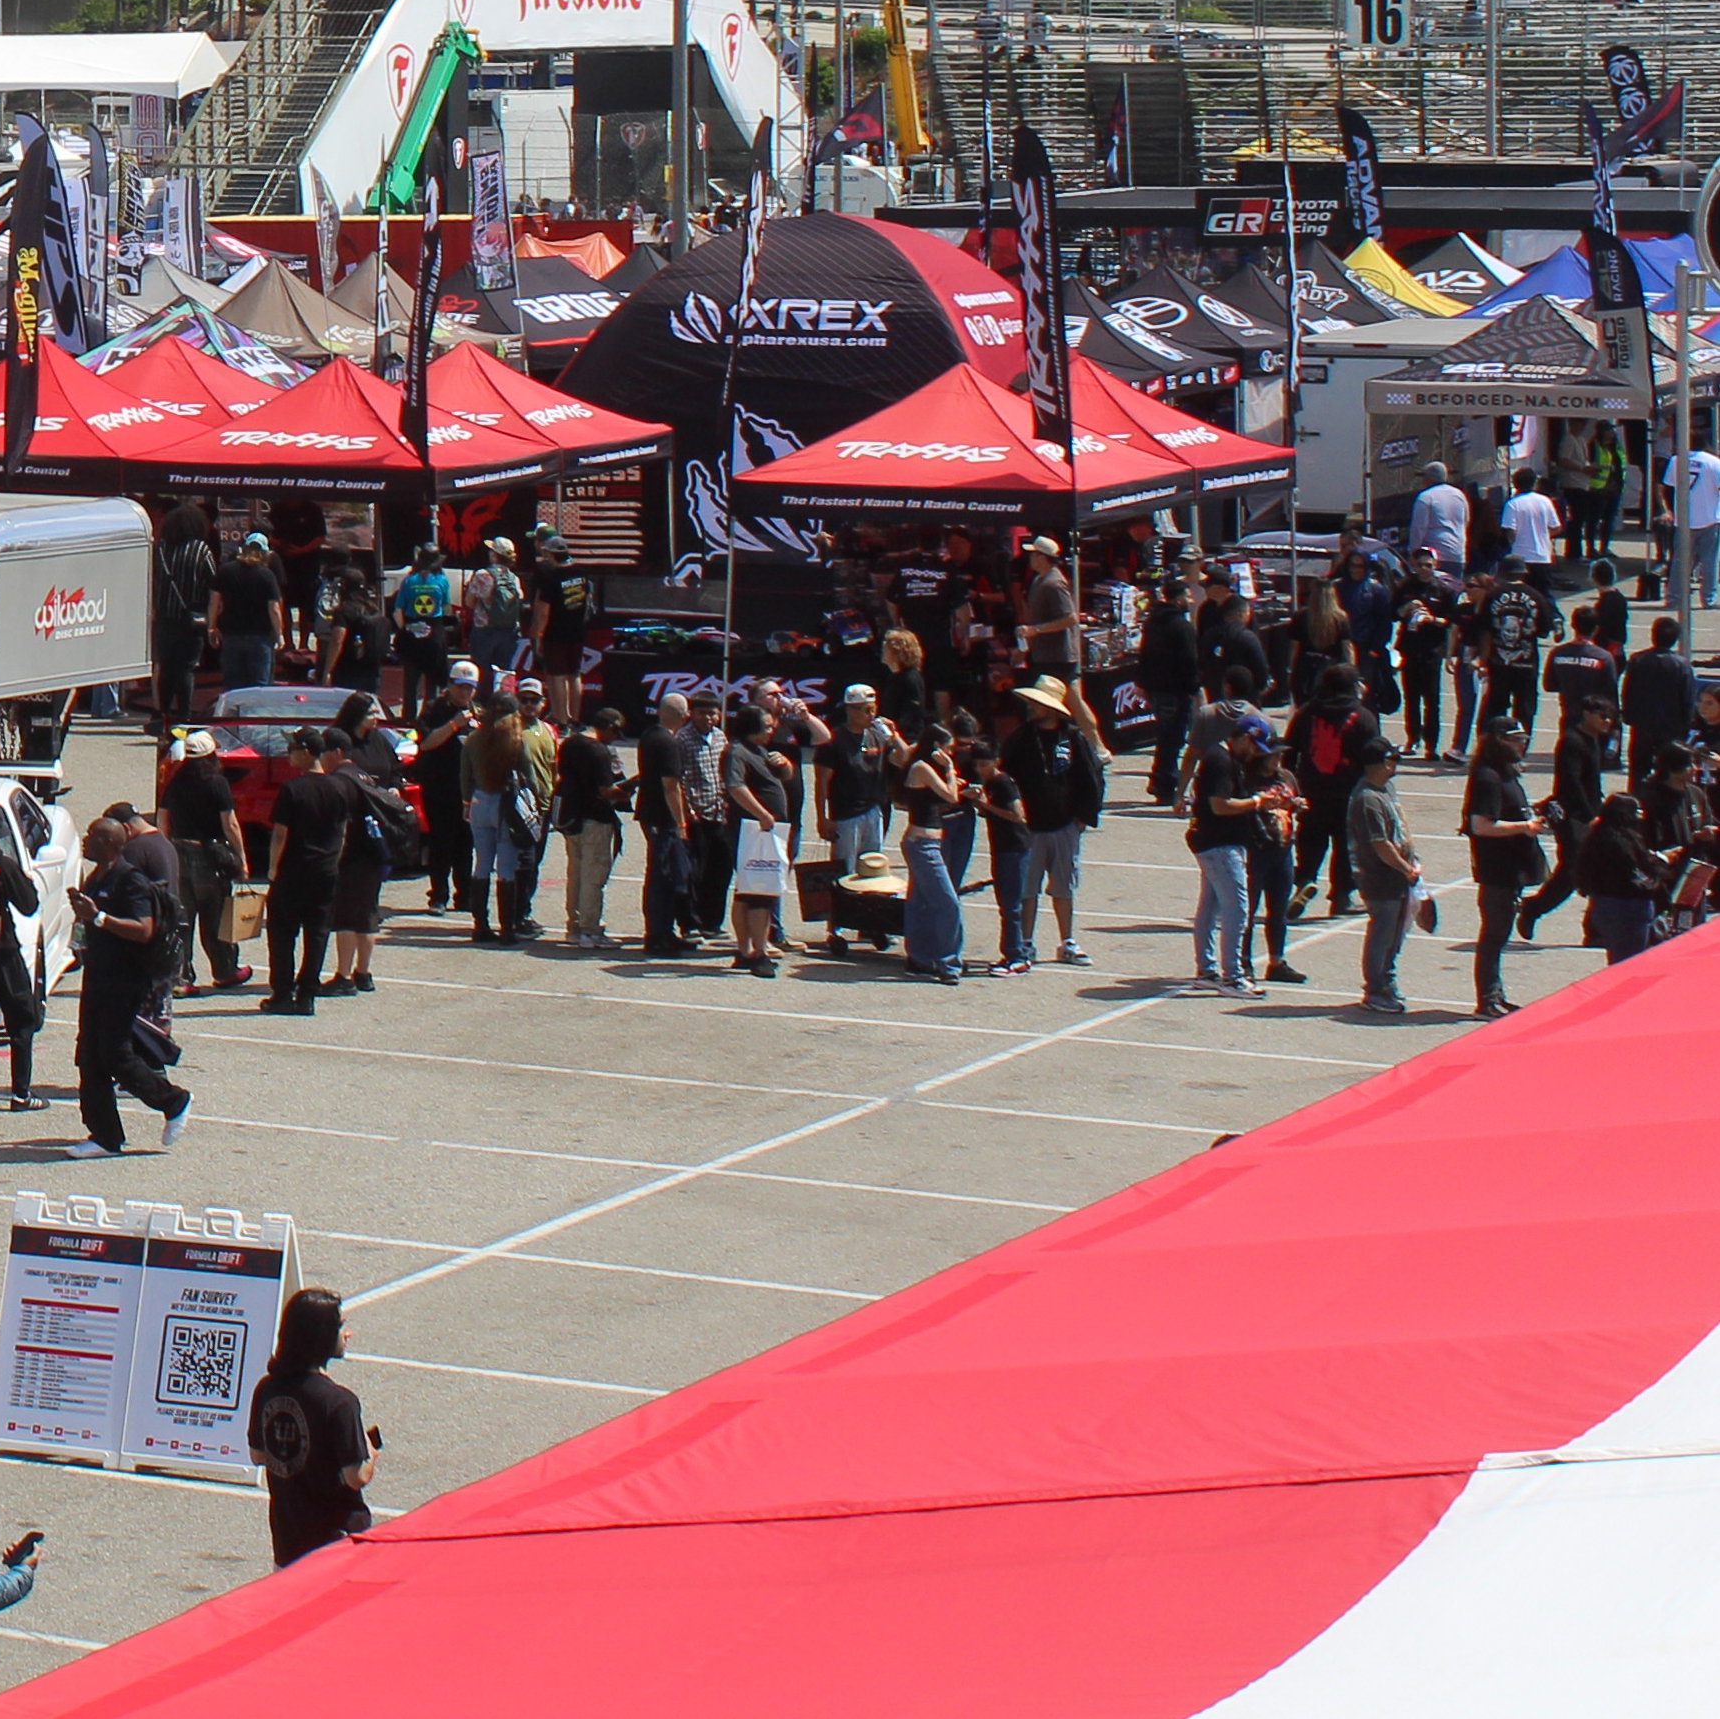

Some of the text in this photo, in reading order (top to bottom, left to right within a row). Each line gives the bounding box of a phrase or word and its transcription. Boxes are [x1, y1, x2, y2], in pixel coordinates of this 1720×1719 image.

[1207, 212, 1263, 233] GR
[1609, 249, 1623, 302] RACING
[724, 333, 888, 348] apharexusa.com
[1506, 363, 1589, 376] FORGED
[1416, 390, 1601, 410] BCFORGED-NA.COM
[219, 430, 379, 450] TRAXXAS
[835, 440, 1011, 462] TRAXXAS
[23, 465, 71, 477] Control
[168, 474, 186, 484] The
[193, 475, 241, 486] Fastest
[242, 476, 280, 487] Name
[296, 477, 334, 488] Radio
[335, 480, 386, 491] Control
[565, 486, 607, 498] CREW
[781, 495, 807, 505] The
[808, 496, 862, 507] Fastest
[863, 498, 904, 508] Name
[922, 500, 965, 510] Radio
[967, 501, 1023, 513] Control
[34, 588, 107, 627] wilwood
[56, 623, 106, 641] DISC BRAKES
[48, 1236, 104, 1253] FORMULA DRIFT
[185, 1249, 242, 1266] FORMULA DRIFT
[180, 1288, 239, 1306] FAN SURVEY
